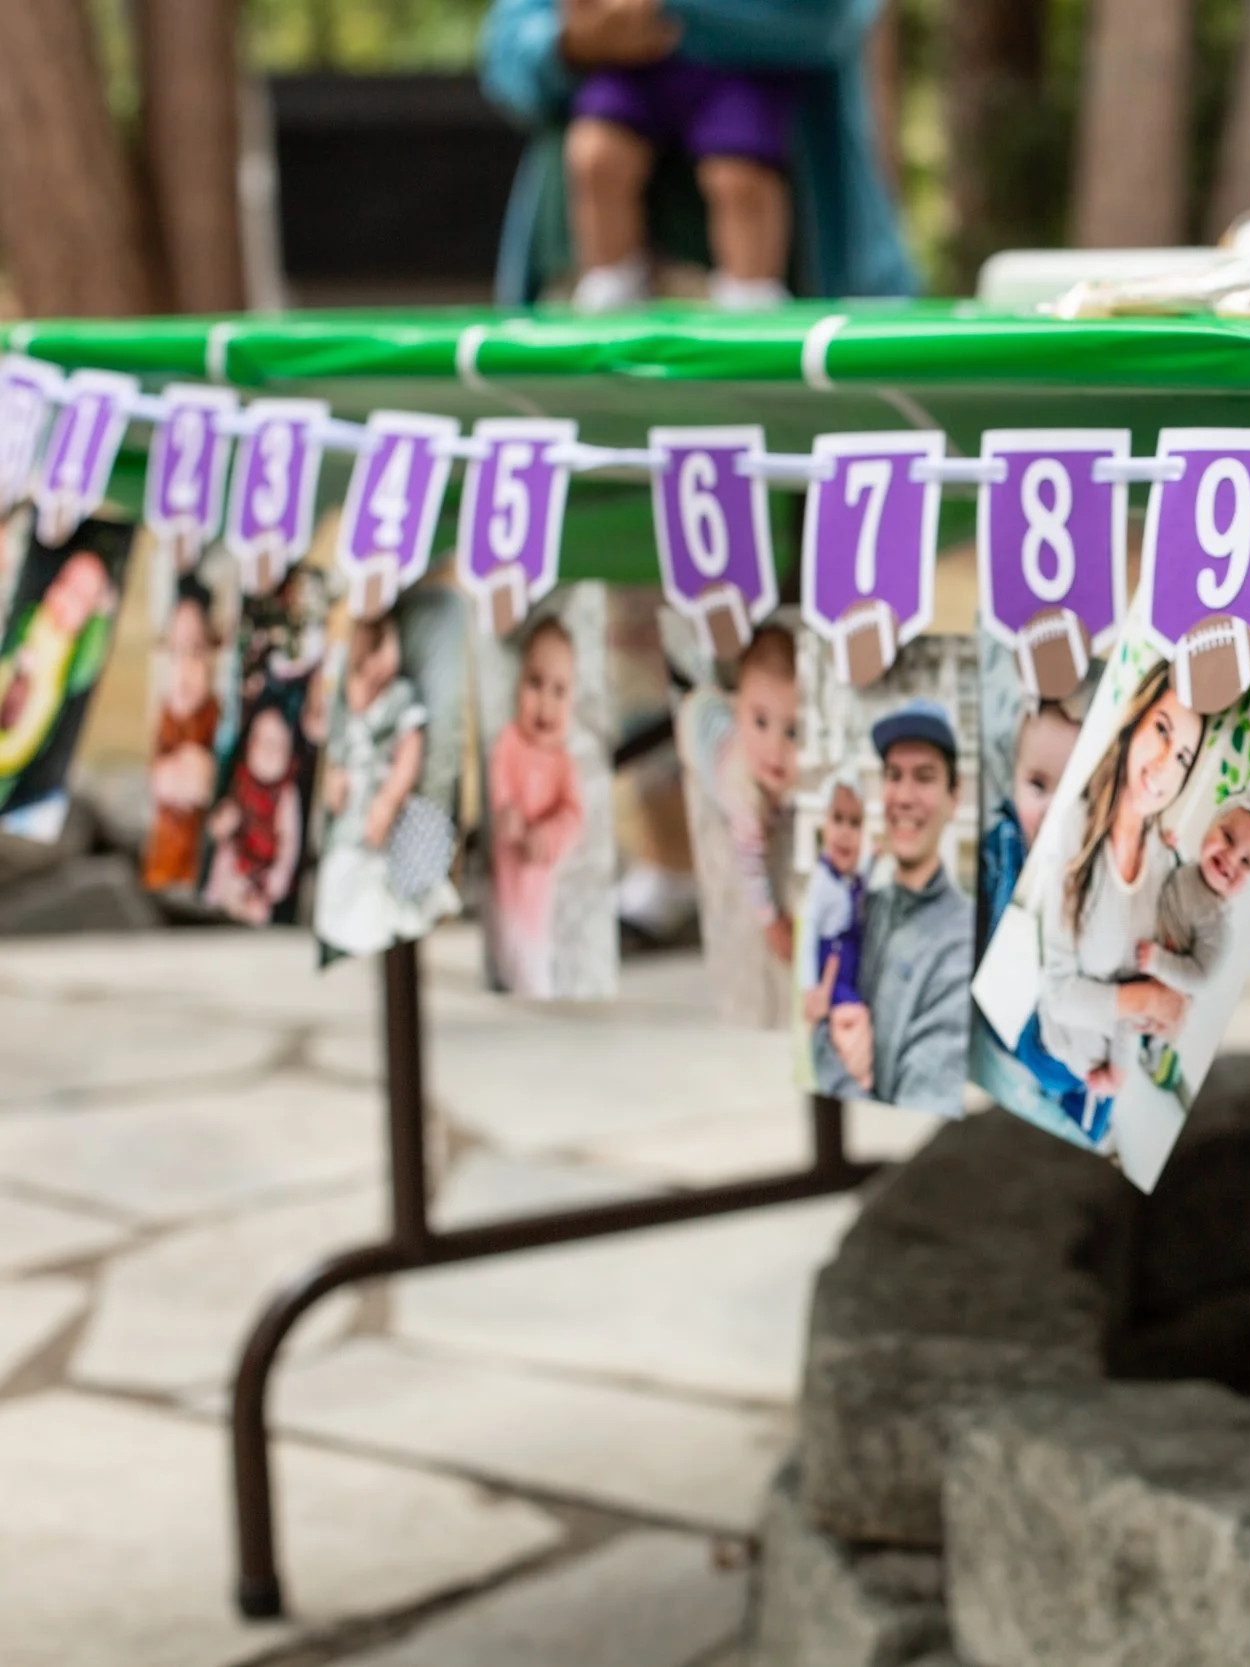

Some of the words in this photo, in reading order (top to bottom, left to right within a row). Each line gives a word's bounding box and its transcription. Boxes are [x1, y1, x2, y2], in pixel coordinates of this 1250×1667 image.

[167, 409, 206, 508] 2
[253, 421, 293, 526] 3
[368, 436, 414, 548] 4
[488, 444, 534, 561] 5
[678, 450, 730, 578] 6
[844, 459, 892, 595] 7
[1021, 458, 1075, 602] 8
